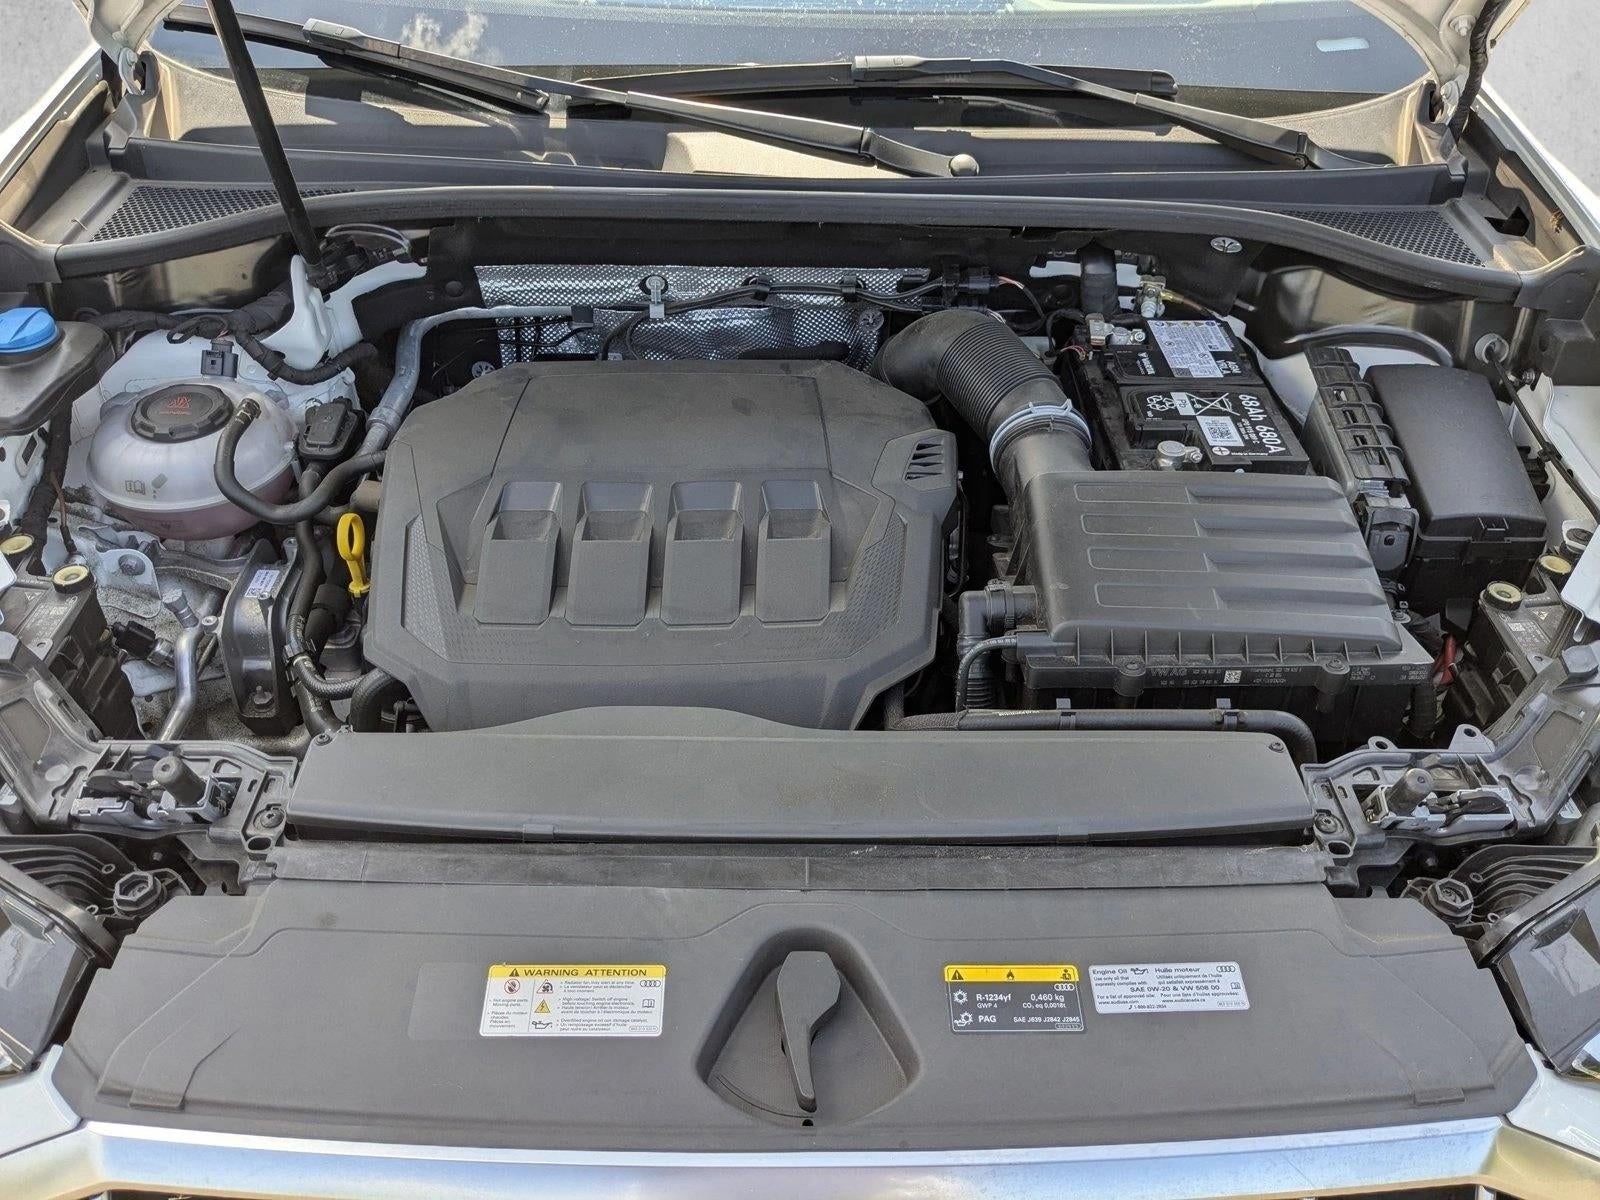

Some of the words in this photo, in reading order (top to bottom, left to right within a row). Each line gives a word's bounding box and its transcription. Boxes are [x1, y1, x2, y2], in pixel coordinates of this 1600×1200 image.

[1238, 394, 1268, 421] 68Ah
[1256, 425, 1286, 454] 680A
[976, 993, 1011, 1002] R-1234yf
[1054, 993, 1064, 1002] kg
